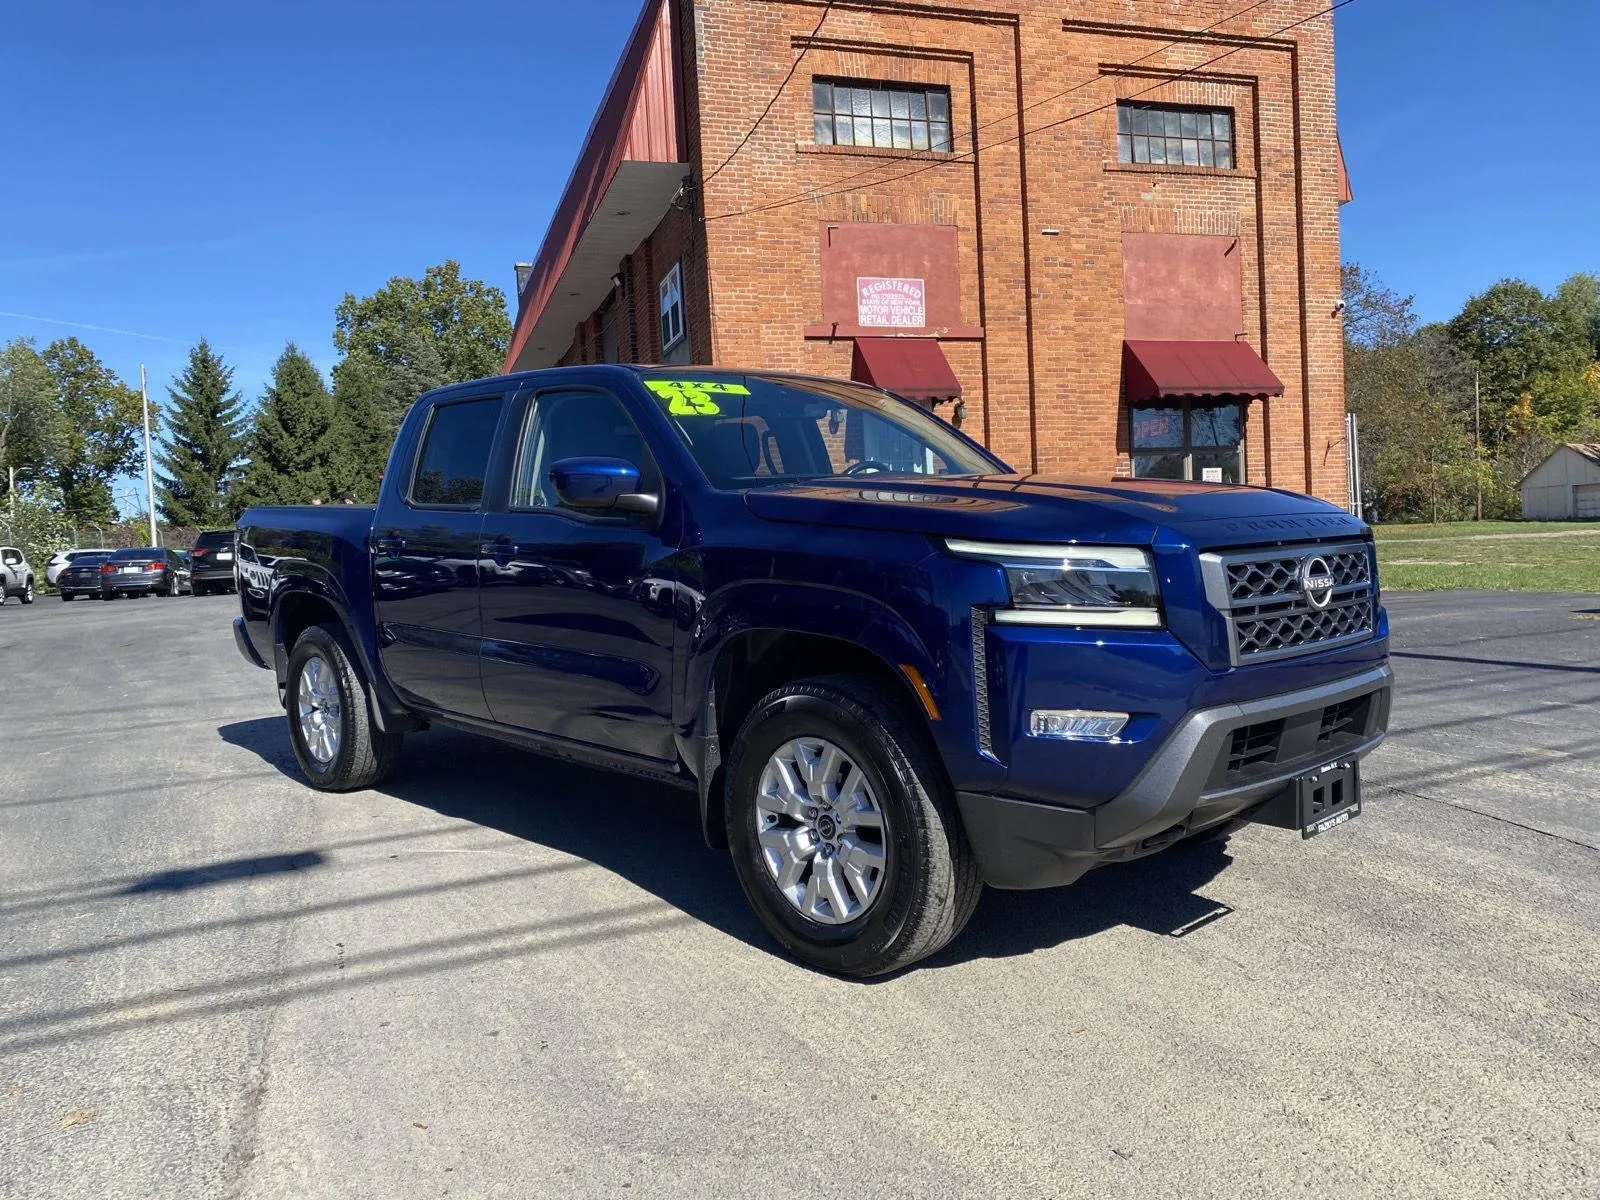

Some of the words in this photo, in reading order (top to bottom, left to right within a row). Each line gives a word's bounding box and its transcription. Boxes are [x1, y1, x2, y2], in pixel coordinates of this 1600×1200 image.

[861, 280, 921, 299] REGISTERED
[861, 305, 889, 314] MOTOR
[891, 305, 924, 316] VEHICLE
[861, 314, 890, 325] RETAIL
[891, 315, 924, 326] DEALER
[656, 389, 721, 416] 23
[1335, 812, 1349, 825] AUTO
